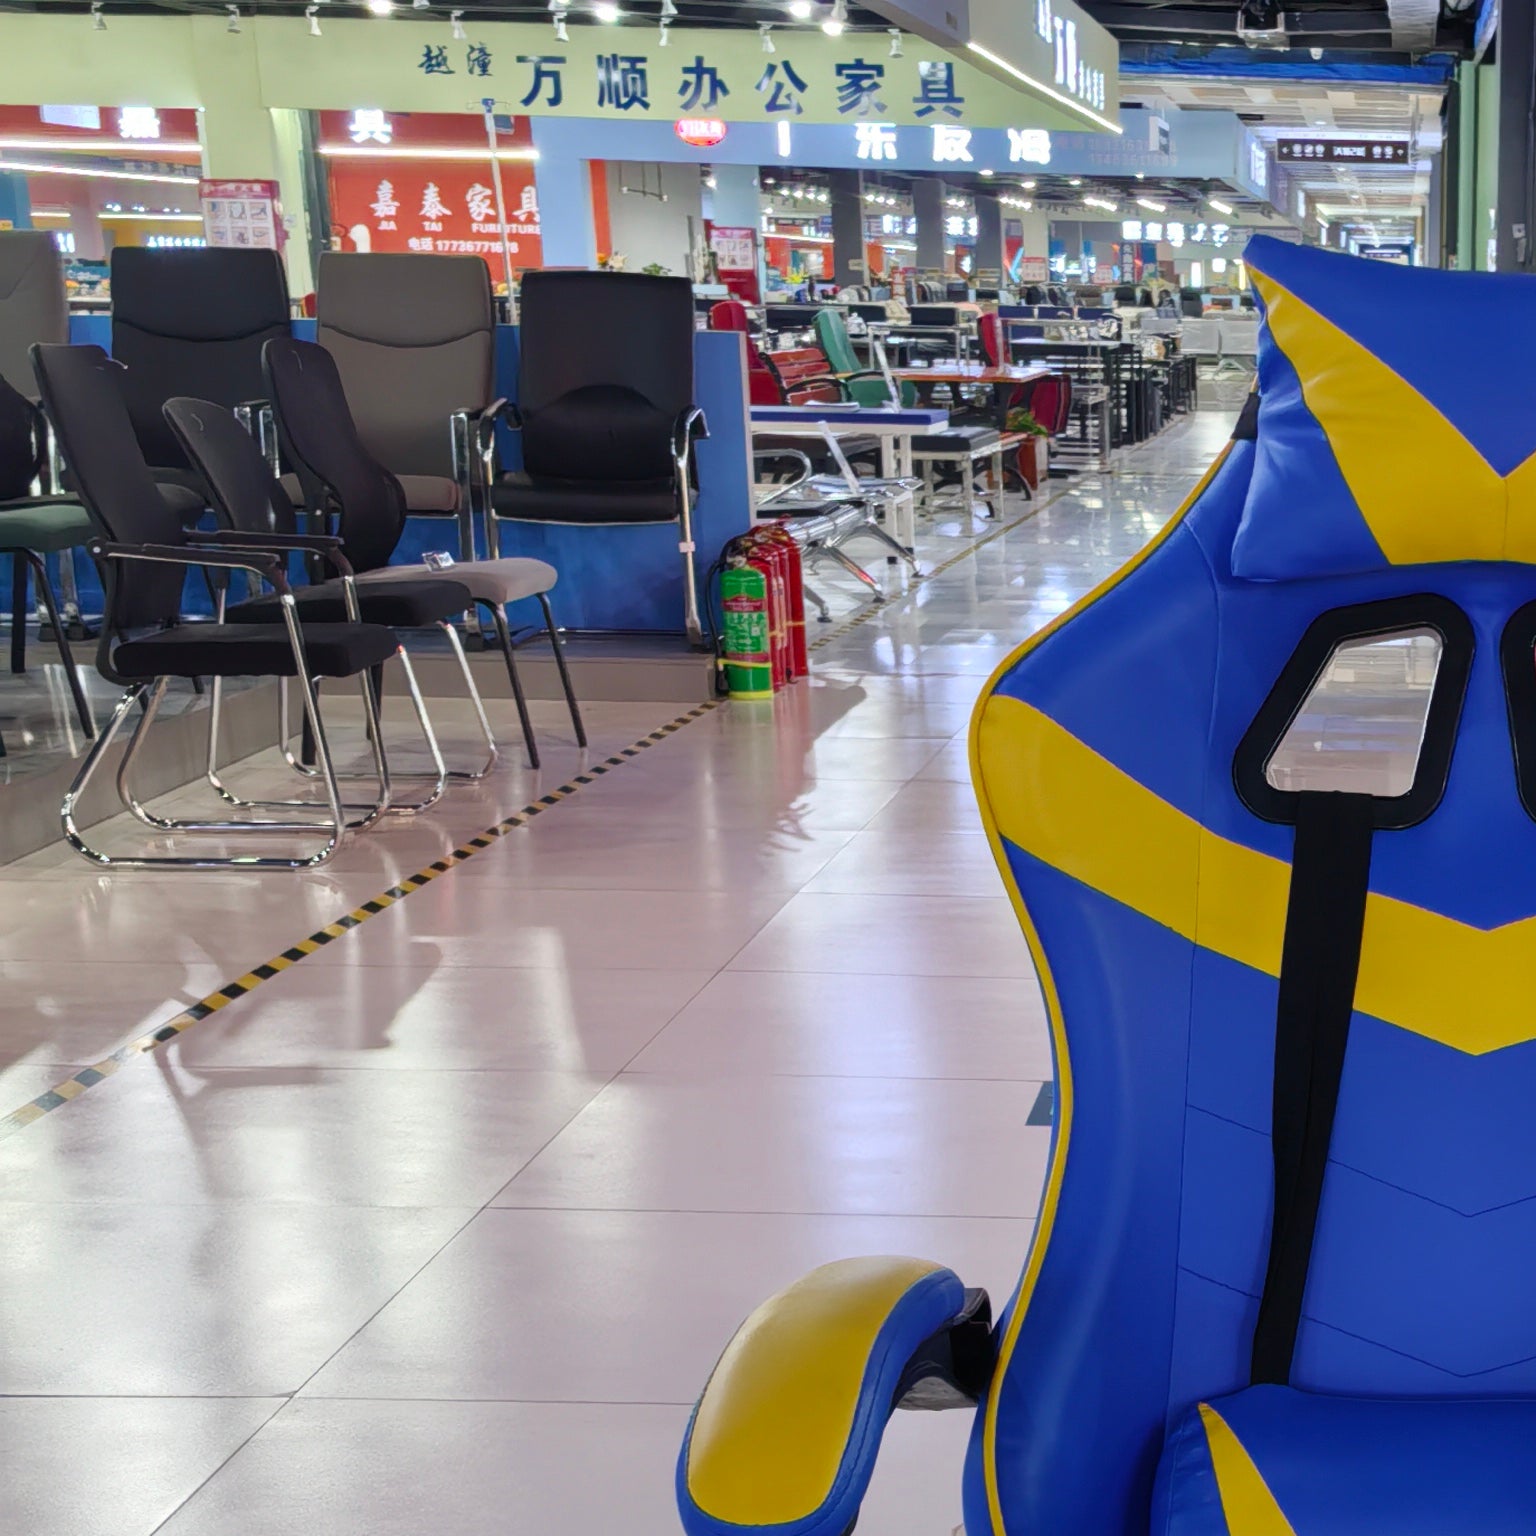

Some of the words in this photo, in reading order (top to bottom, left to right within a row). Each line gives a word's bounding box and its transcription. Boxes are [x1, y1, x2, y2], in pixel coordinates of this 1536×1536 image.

[515, 53, 965, 118] 万顺办公家具
[370, 180, 541, 222] 嘉泰家具
